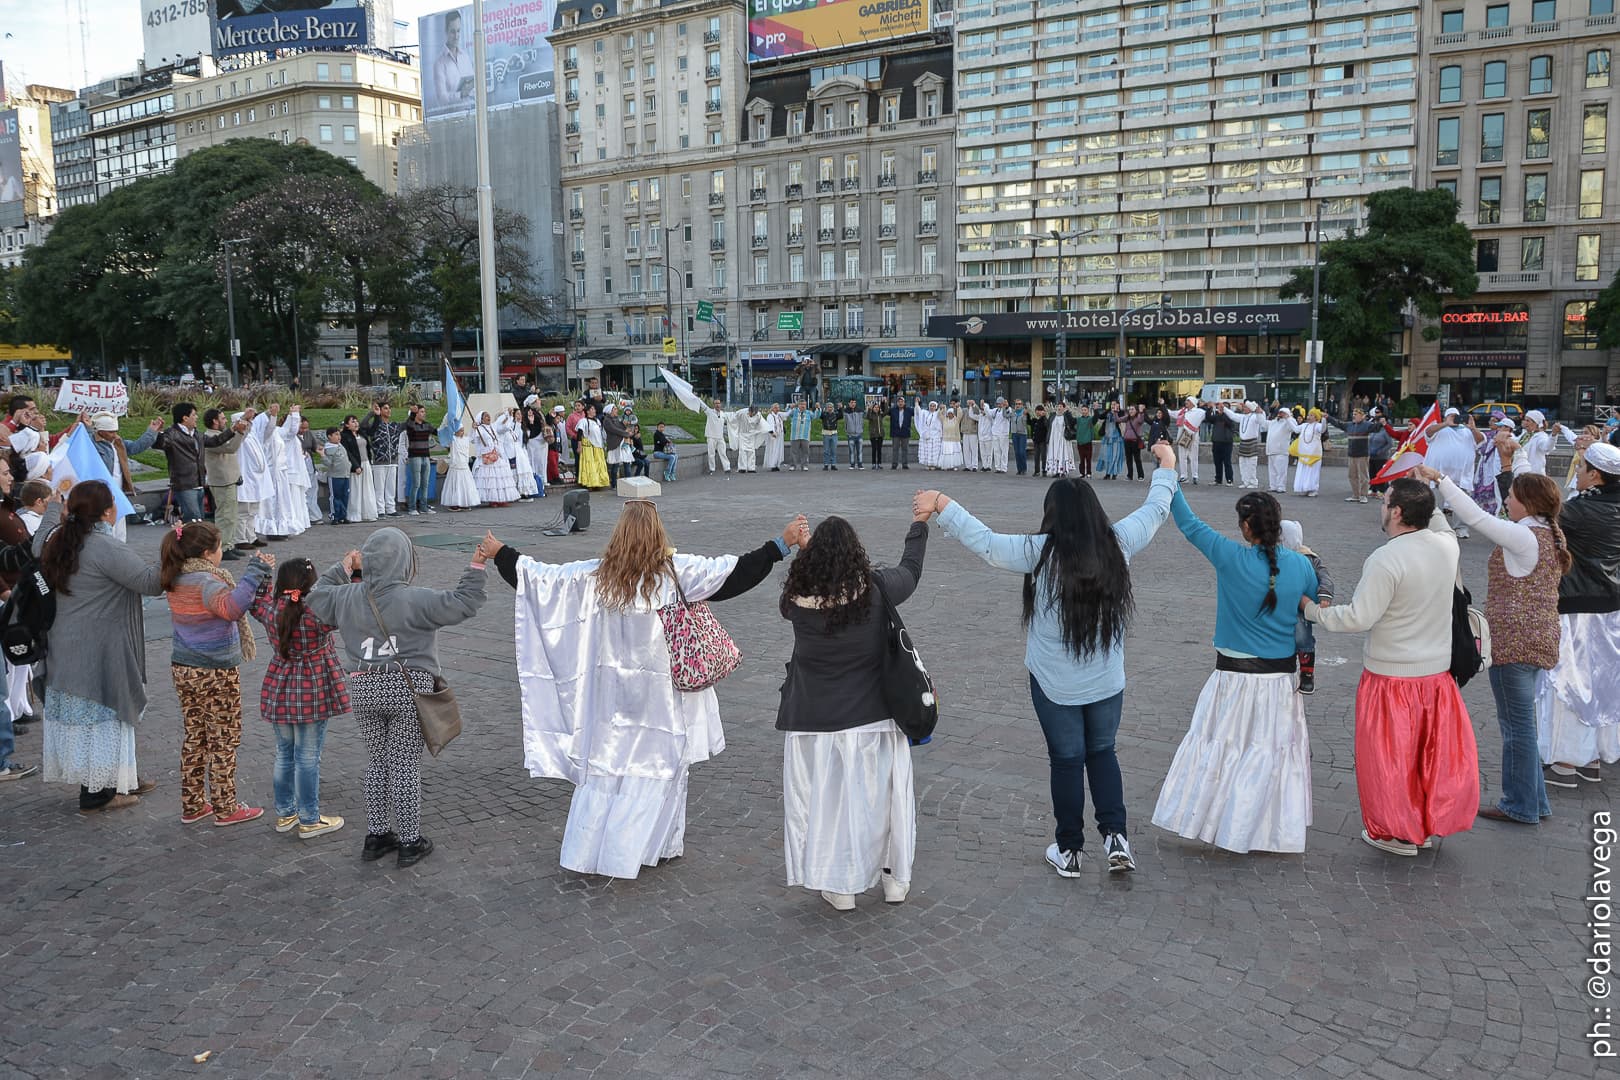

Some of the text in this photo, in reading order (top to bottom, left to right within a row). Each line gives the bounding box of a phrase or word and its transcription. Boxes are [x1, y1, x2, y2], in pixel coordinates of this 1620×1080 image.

[482, 0, 543, 23] onexiones
[859, 0, 922, 17] GABRIELA
[880, 8, 922, 25] Michetti
[216, 16, 358, 49] Mercedes-Benz
[487, 22, 549, 45] empresas
[765, 32, 786, 49] pro
[518, 36, 535, 47] hoy
[523, 80, 551, 91] FiberCorp
[1026, 308, 1281, 330] www.hotelesglobales.com
[1442, 311, 1529, 324] COCKTAIL BAR
[360, 635, 399, 660] 14
